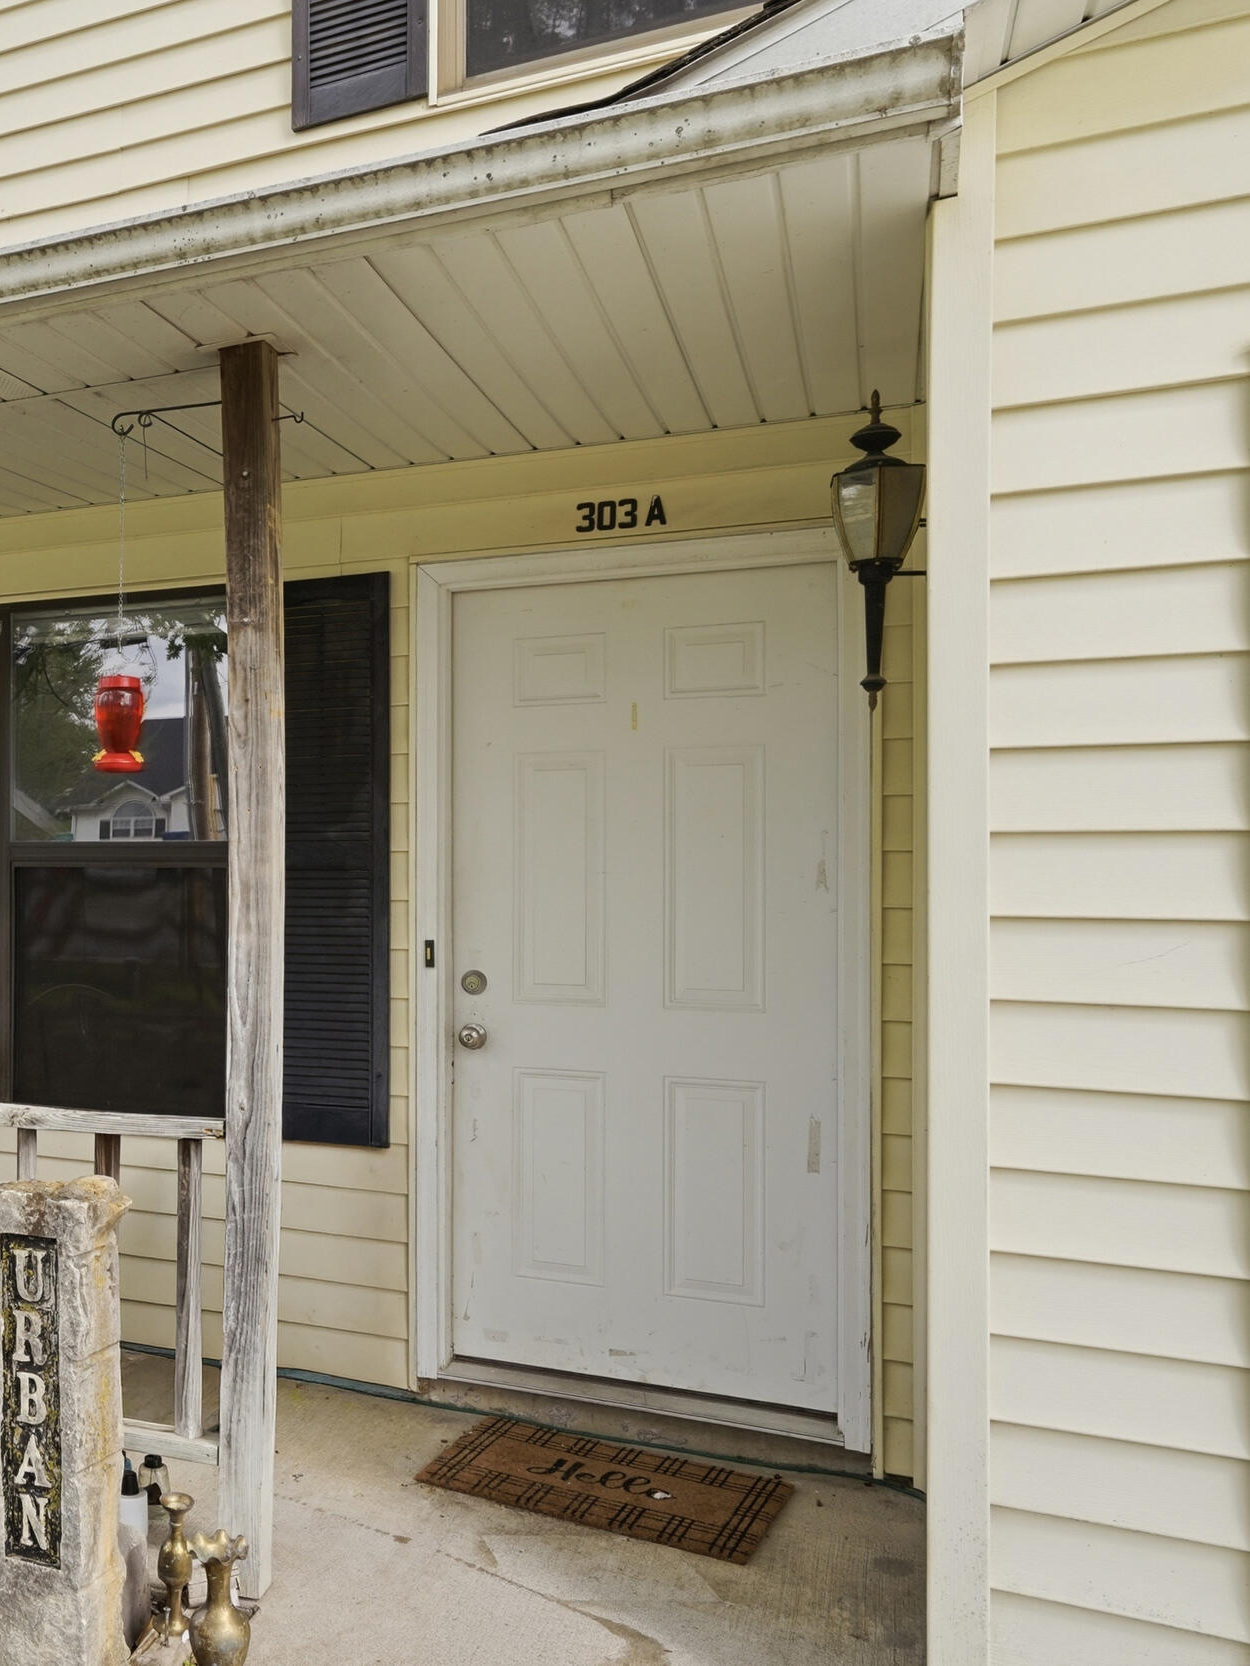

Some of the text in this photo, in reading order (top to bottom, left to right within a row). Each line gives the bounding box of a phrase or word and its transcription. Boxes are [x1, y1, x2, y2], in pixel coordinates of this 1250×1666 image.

[575, 494, 667, 533] 303 A
[12, 1248, 51, 1552] URBAN
